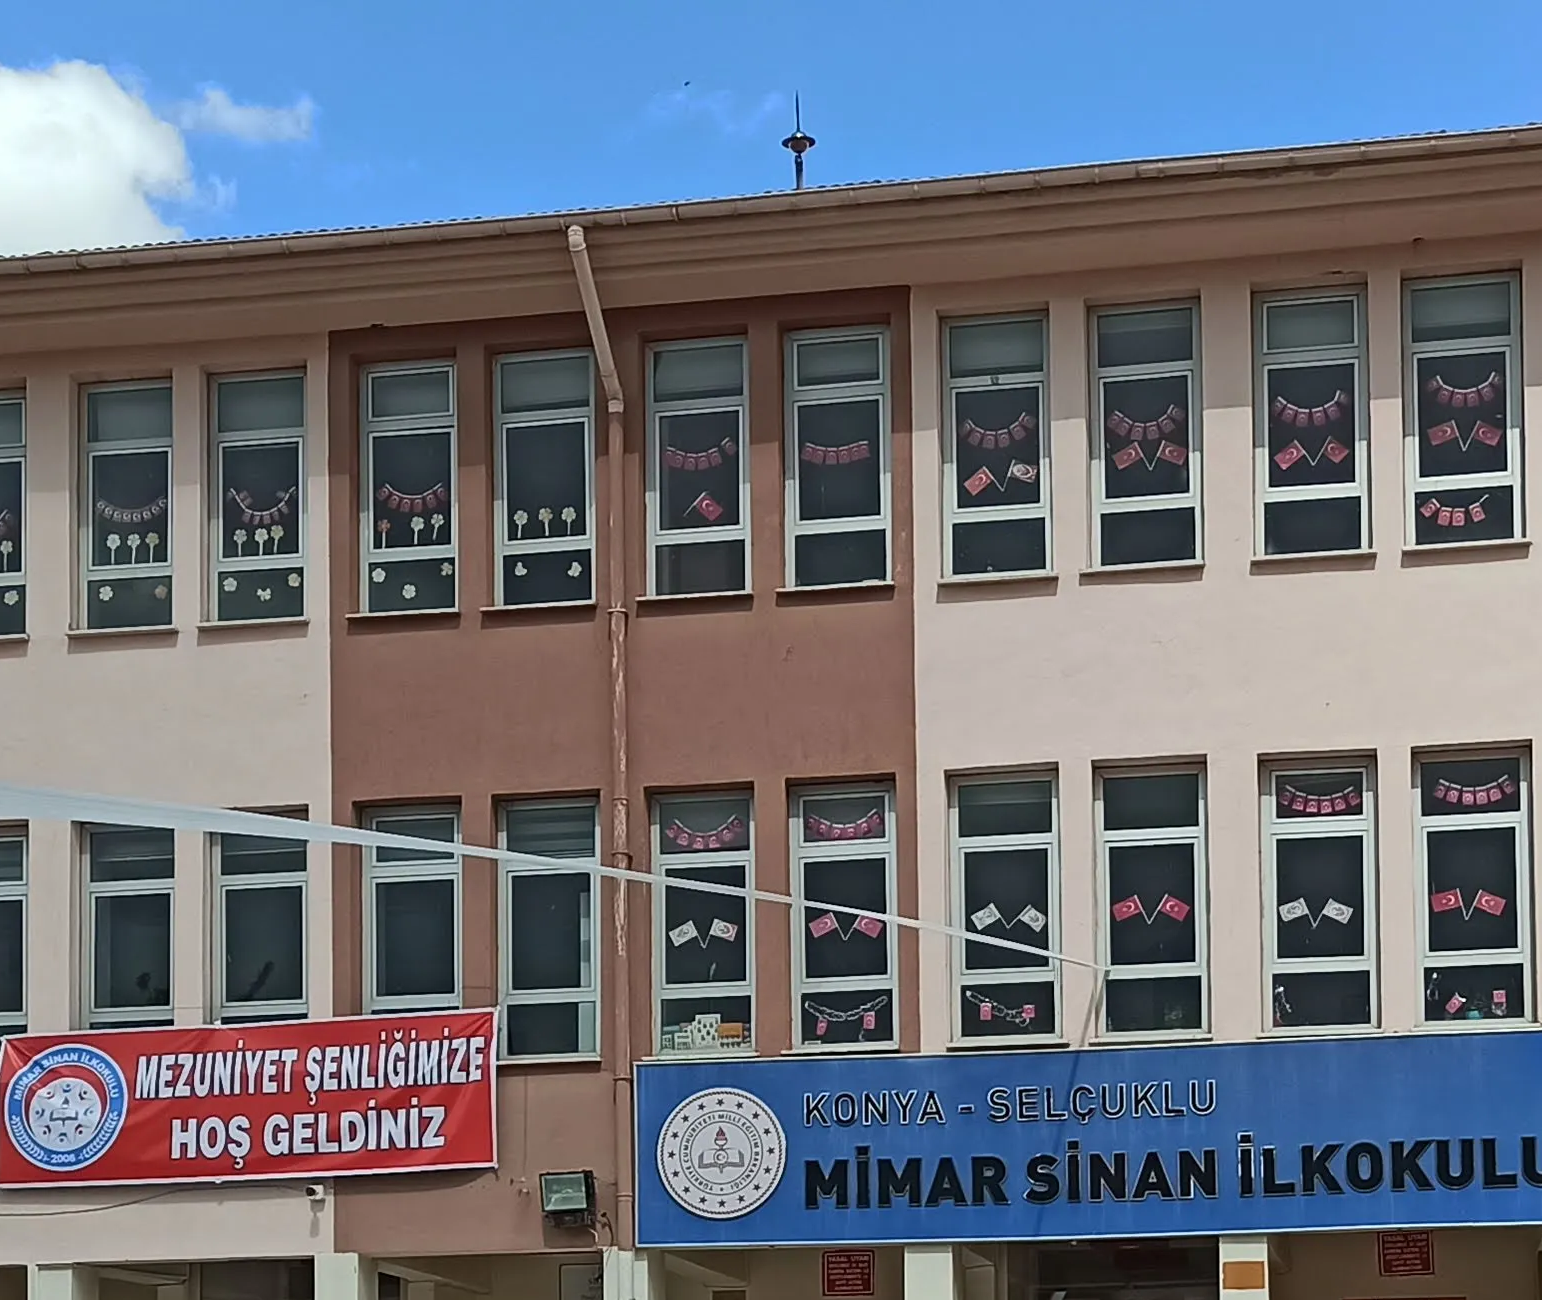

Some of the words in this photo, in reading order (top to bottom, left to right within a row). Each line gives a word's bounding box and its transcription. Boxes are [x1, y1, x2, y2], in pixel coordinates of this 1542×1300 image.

[135, 1040, 298, 1100] MEZUNİYET
[305, 1027, 485, 1104] ŞENLİĞİMİZE
[170, 1115, 252, 1168] HOŞ
[263, 1096, 447, 1156] GELDİNİZ
[803, 1090, 947, 1128] KONYA
[987, 1079, 1217, 1125] SELÇUKLU
[804, 1145, 1011, 1210] MİMAR
[1024, 1139, 1220, 1204] SİNAN
